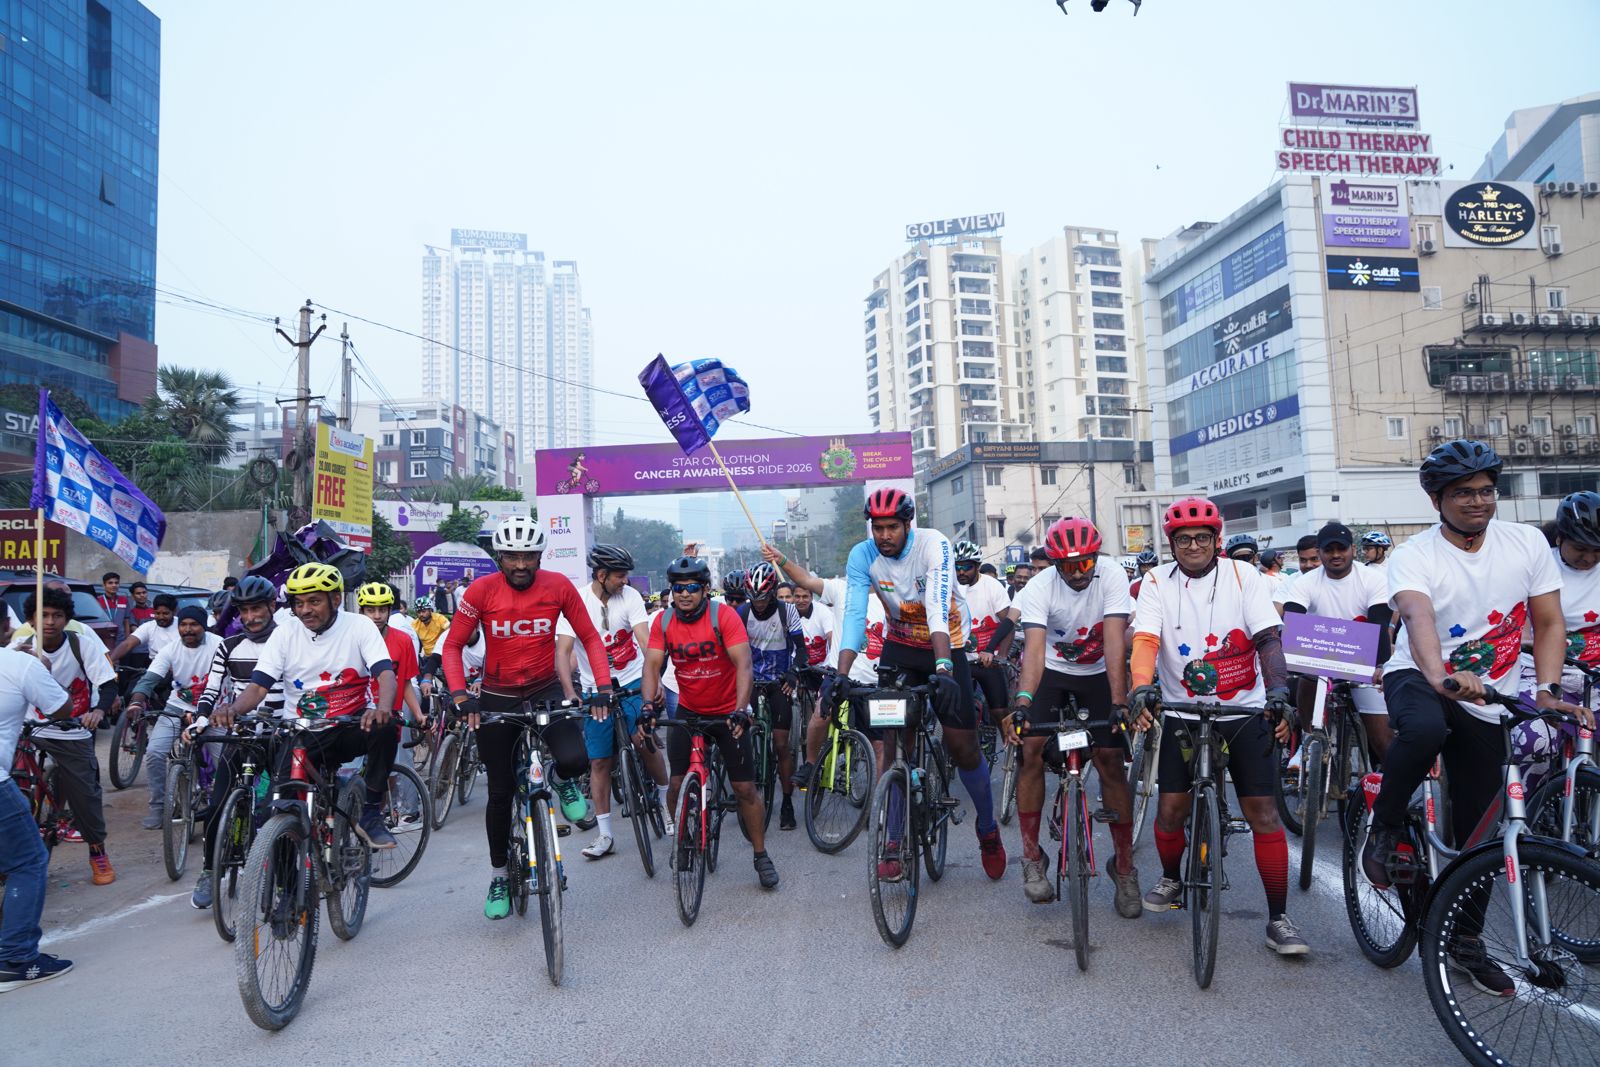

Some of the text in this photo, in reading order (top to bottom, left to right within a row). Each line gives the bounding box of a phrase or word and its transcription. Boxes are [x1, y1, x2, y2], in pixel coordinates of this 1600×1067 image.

[1326, 92, 1410, 114] MARIN'S
[1283, 129, 1430, 152] CHILD THERAPY
[1278, 152, 1439, 175] SPEECH THERAPY
[1351, 190, 1394, 202] MARIN'S
[1335, 216, 1398, 227] CHILD THERAPY
[1458, 210, 1524, 222] HARLEY'S
[906, 212, 1004, 238] GOLF VIEW
[1333, 226, 1402, 237] SPEECH THERAPY
[1191, 341, 1270, 391] ACCURATE
[5, 412, 41, 433] STA
[1207, 408, 1264, 441] MEDICS
[672, 457, 700, 467] STAR
[634, 464, 813, 480] CANCER AWARENESS RIDE 2026
[1213, 473, 1250, 490] HARLEY'S
[62, 486, 88, 505] STAR
[316, 473, 346, 508] FREE
[91, 524, 114, 543] STAR
[16, 564, 59, 575] MASLA
[941, 572, 949, 583] TO
[491, 618, 553, 637] HCR
[669, 641, 717, 660] HCR
[1312, 638, 1336, 646] Reflect.
[1336, 642, 1362, 650] Protect.
[1335, 648, 1356, 656] Power
[1218, 660, 1233, 669] STAR
[1219, 664, 1242, 674] CANCER
